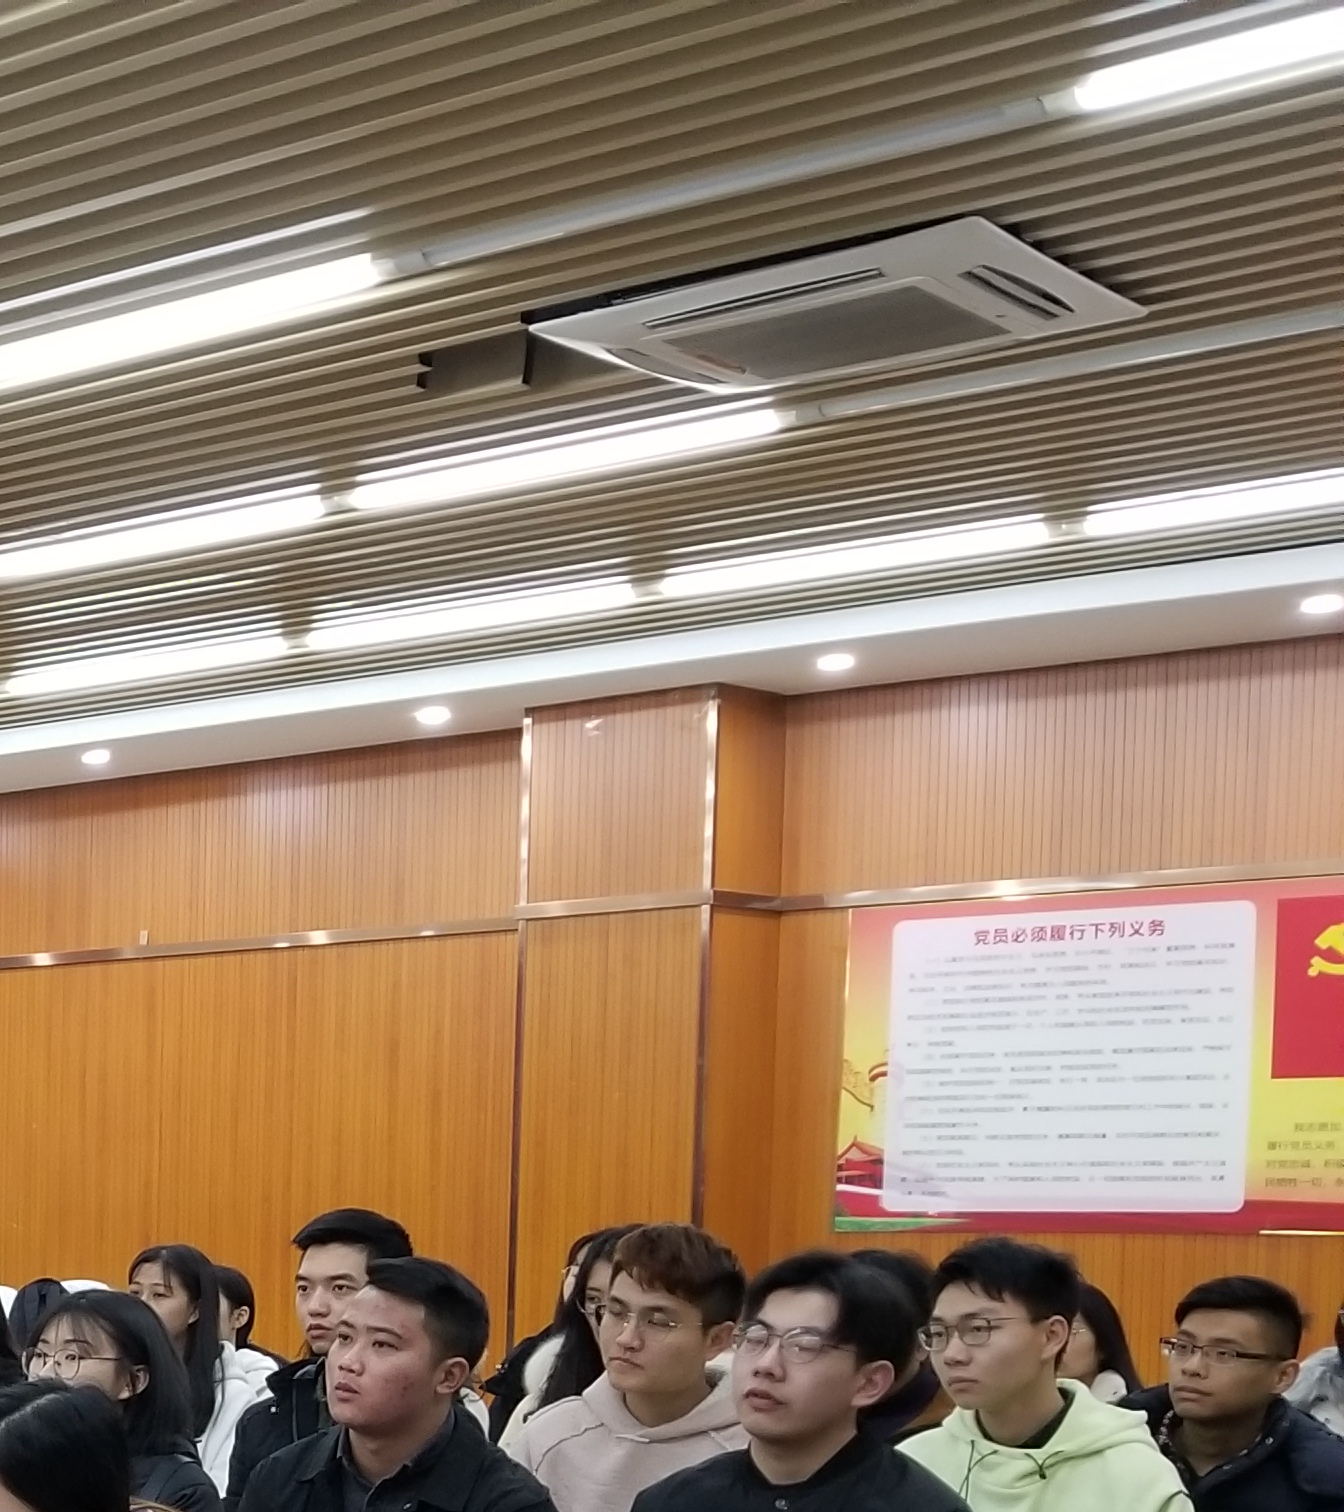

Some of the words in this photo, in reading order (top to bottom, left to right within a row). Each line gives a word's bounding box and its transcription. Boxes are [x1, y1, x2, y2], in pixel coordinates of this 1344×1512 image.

[973, 919, 1166, 946] 党员必须履行下列义务
